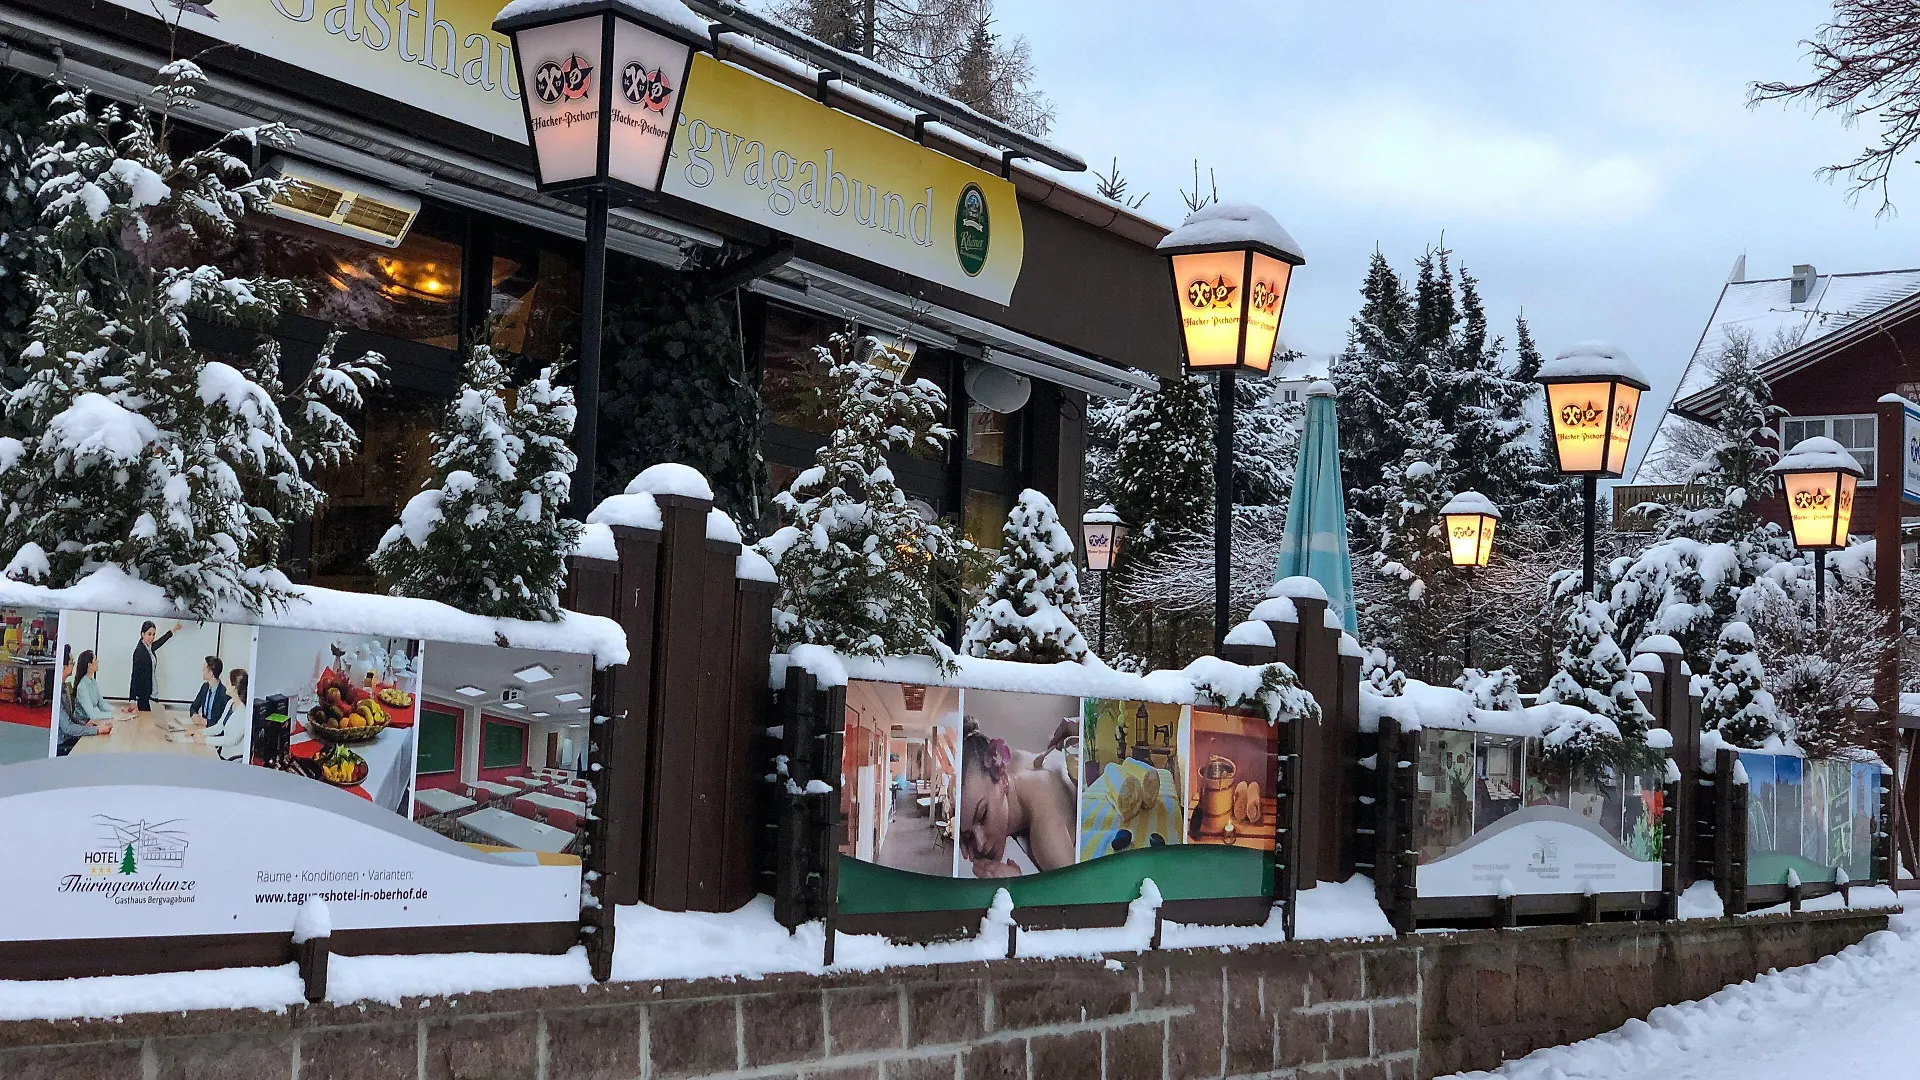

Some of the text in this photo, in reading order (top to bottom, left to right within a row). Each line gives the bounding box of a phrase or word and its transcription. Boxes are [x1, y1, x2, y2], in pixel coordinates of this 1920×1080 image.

[268, 0, 521, 101] asthau
[531, 109, 598, 132] Hacker-Pschorr
[612, 108, 669, 139] Hacker-Pschorr
[670, 111, 934, 248] gvagabund
[84, 851, 119, 864] HOTEL
[57, 873, 197, 899] Thüringenschanze
[256, 869, 414, 883] Räume Konditionen Varianten:
[114, 894, 196, 906] Gasthaus Bergvagabund
[255, 887, 428, 905] www.tagushotel-in-oberhof.de
